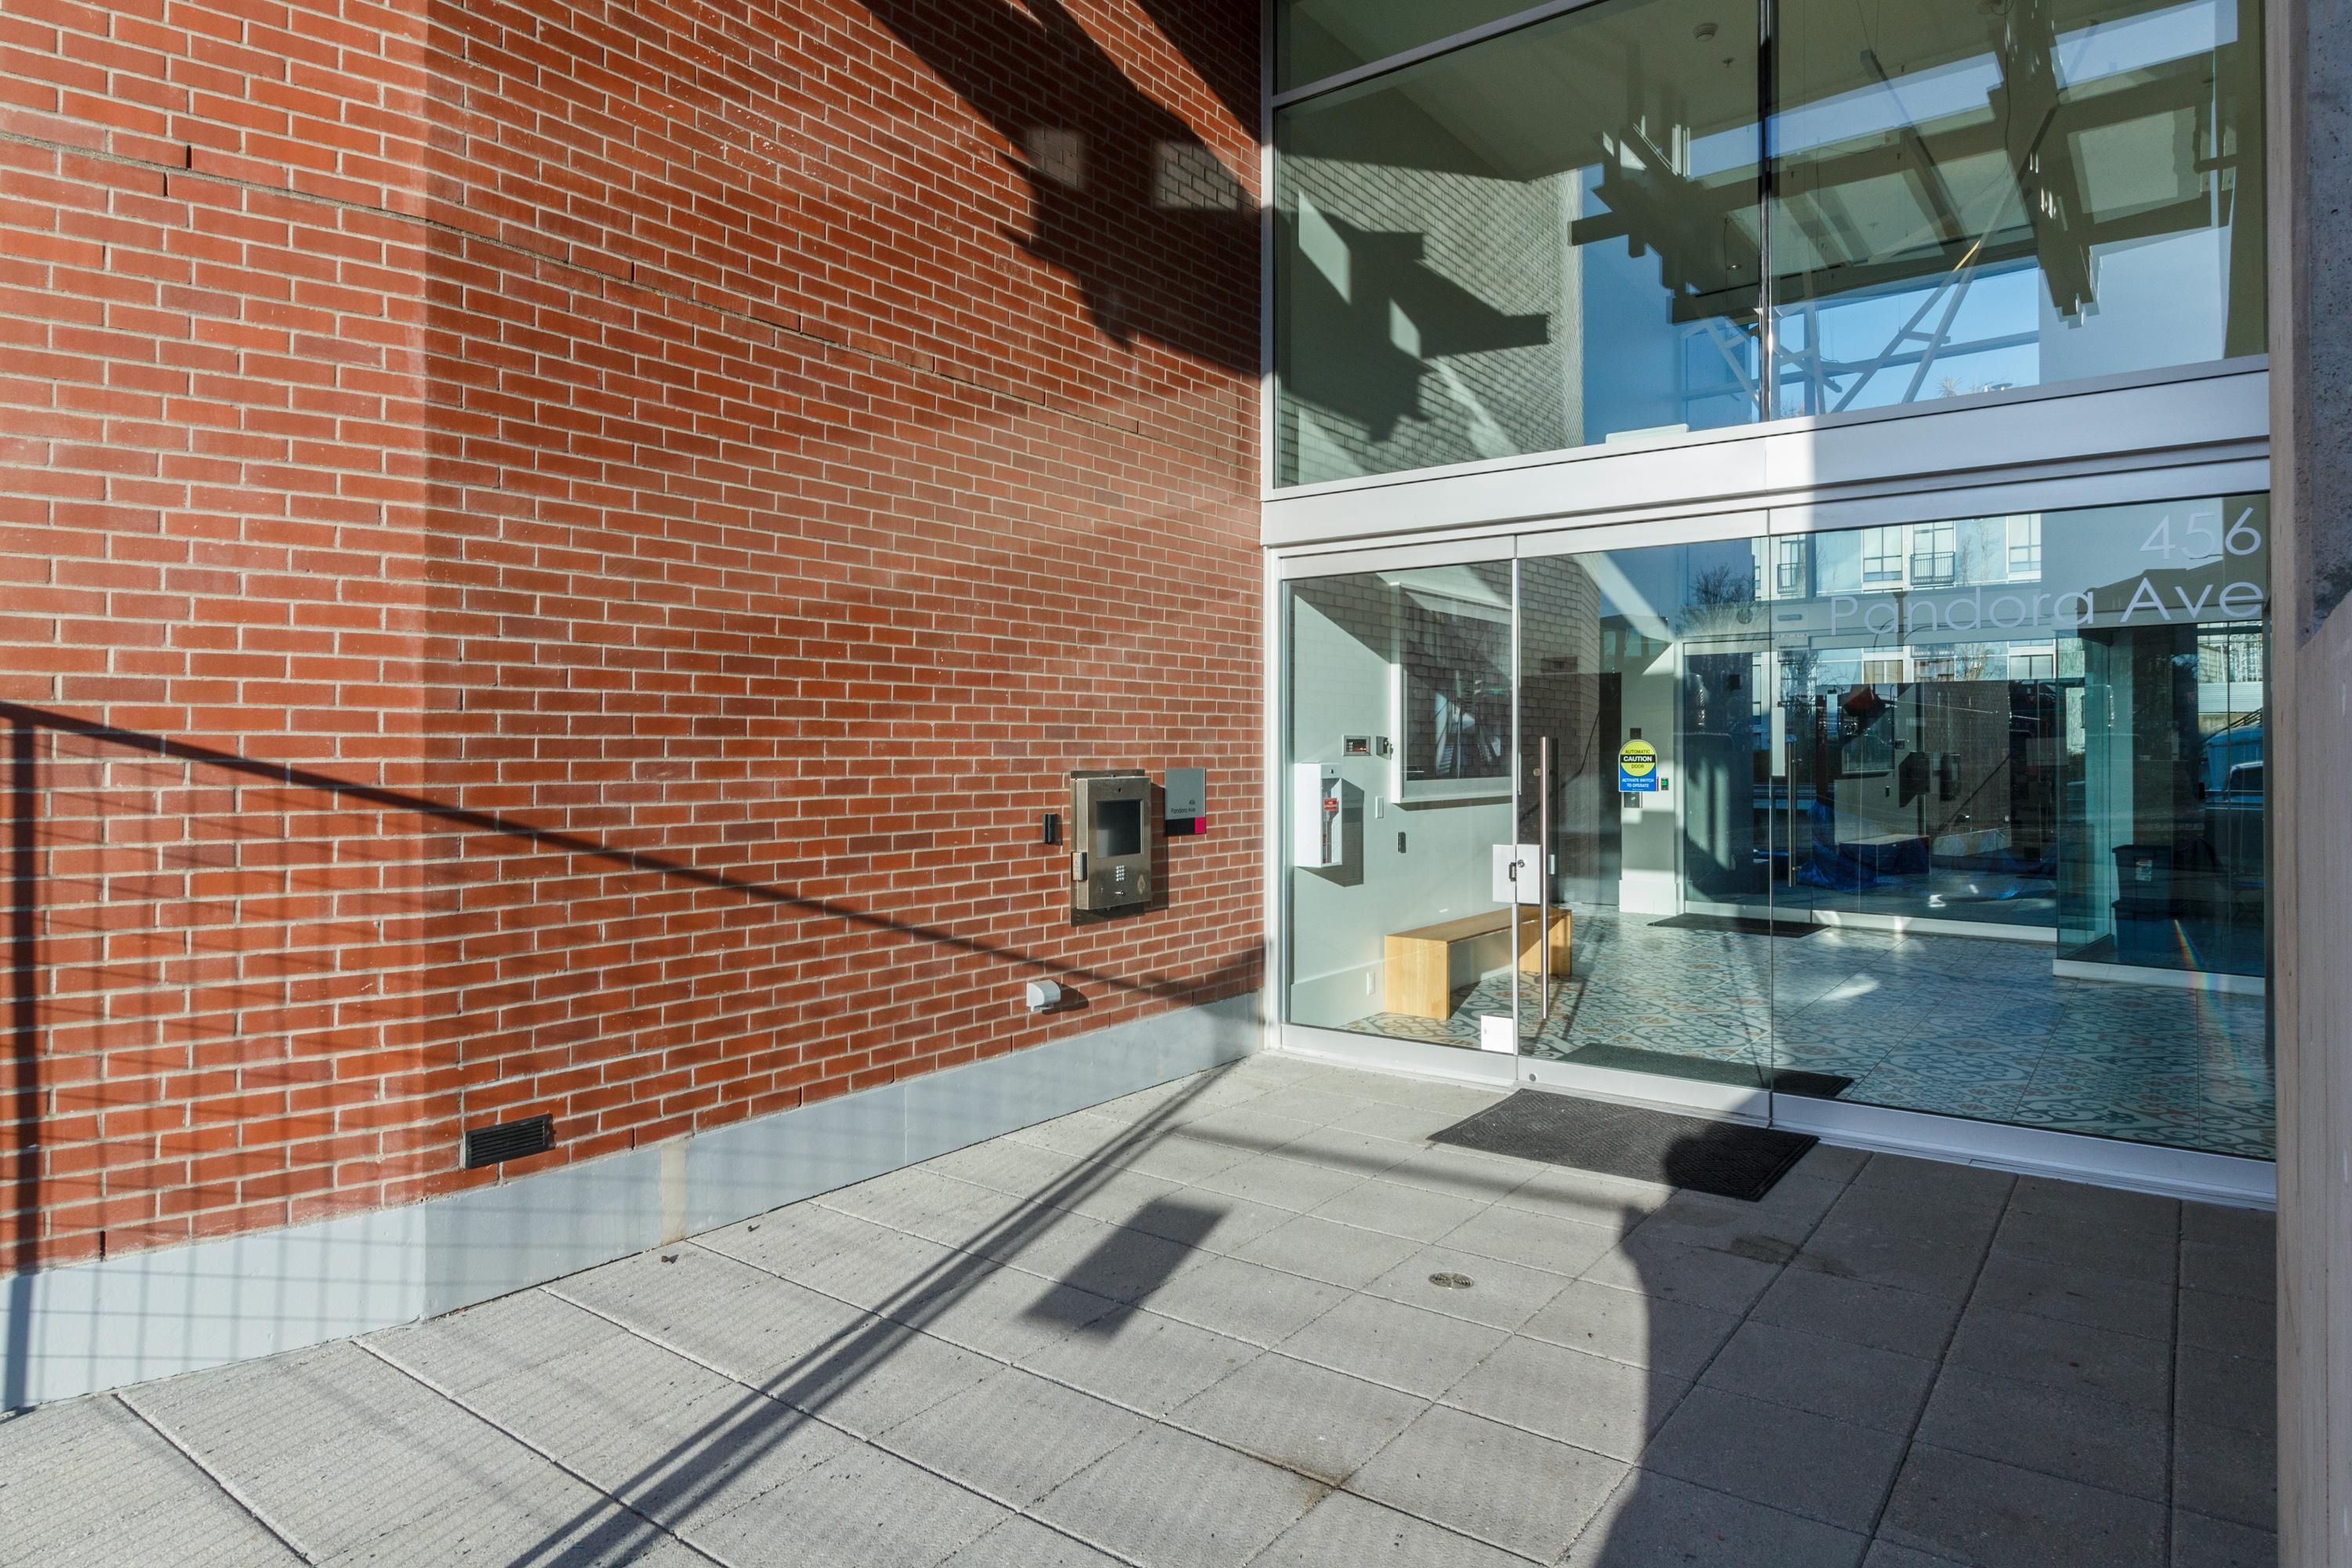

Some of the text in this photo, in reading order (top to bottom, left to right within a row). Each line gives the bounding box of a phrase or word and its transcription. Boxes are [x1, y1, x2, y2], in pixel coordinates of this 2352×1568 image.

[2140, 507, 2261, 561] 456
[1831, 576, 2264, 636] Pandora Ave
